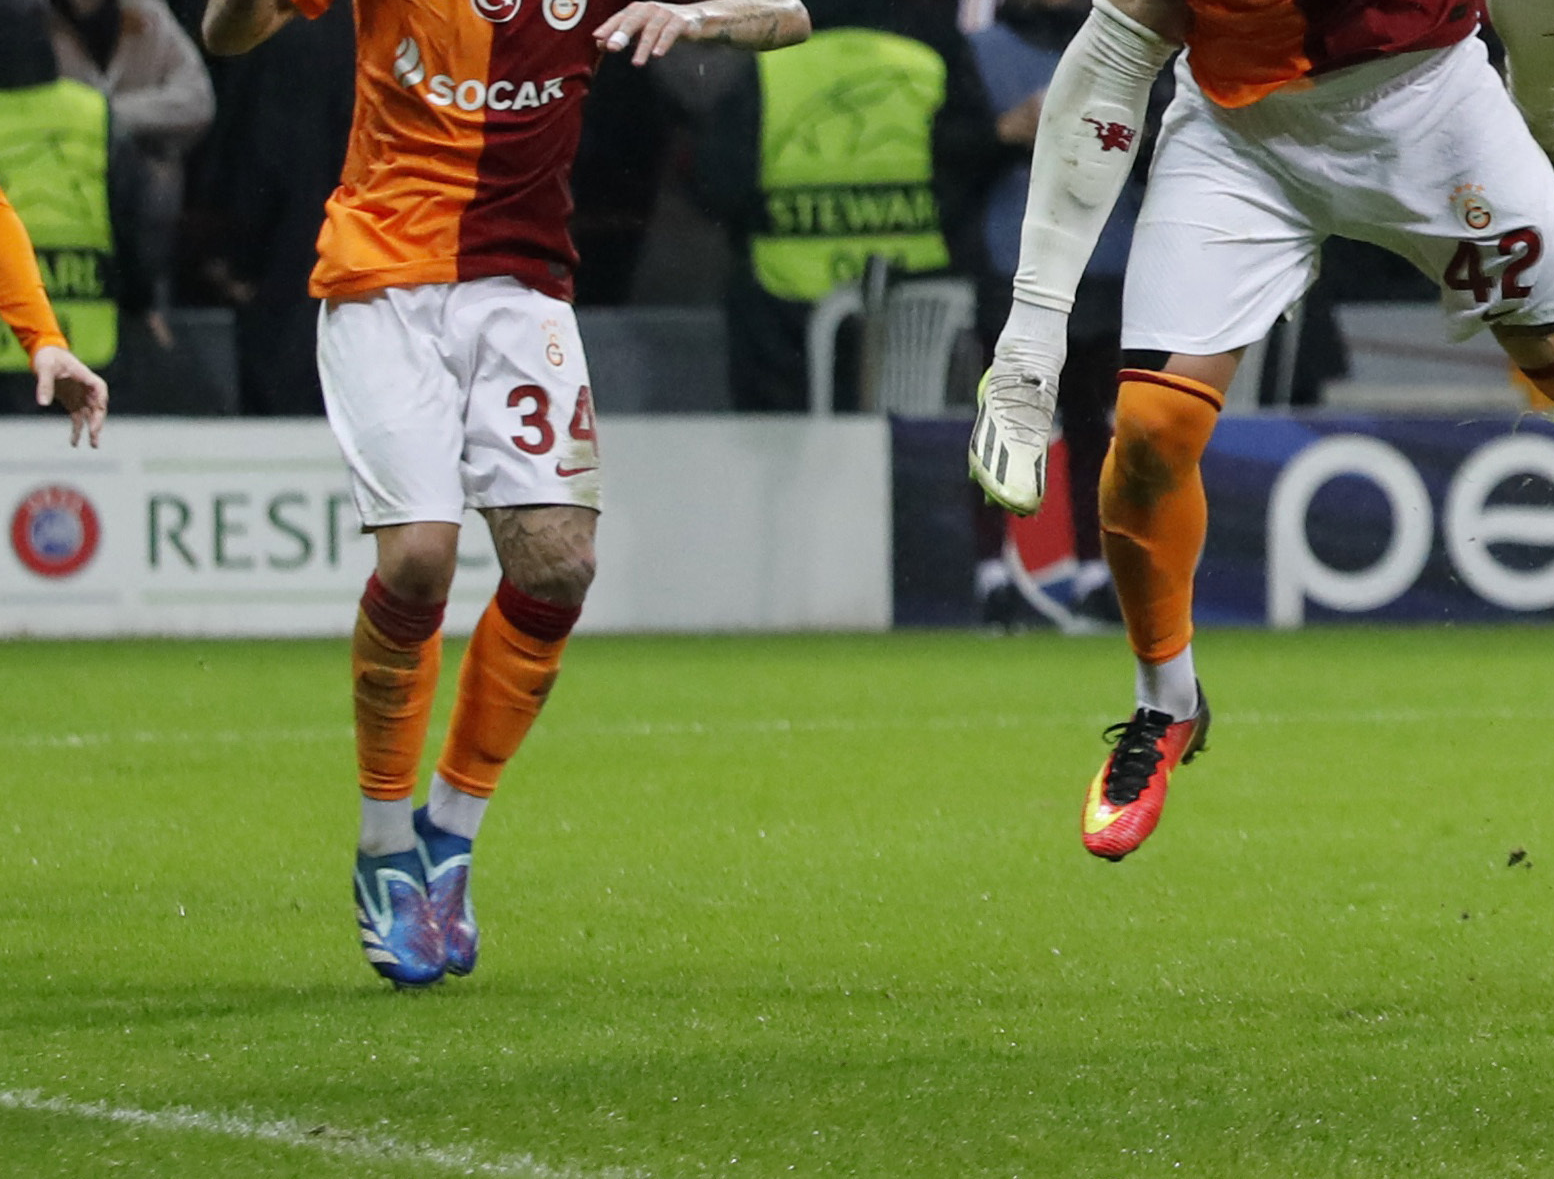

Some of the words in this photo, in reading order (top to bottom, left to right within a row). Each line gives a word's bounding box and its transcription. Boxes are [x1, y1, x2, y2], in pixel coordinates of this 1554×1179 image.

[426, 74, 565, 111] SOCAR
[1443, 226, 1544, 303] 42
[507, 384, 598, 457] 34
